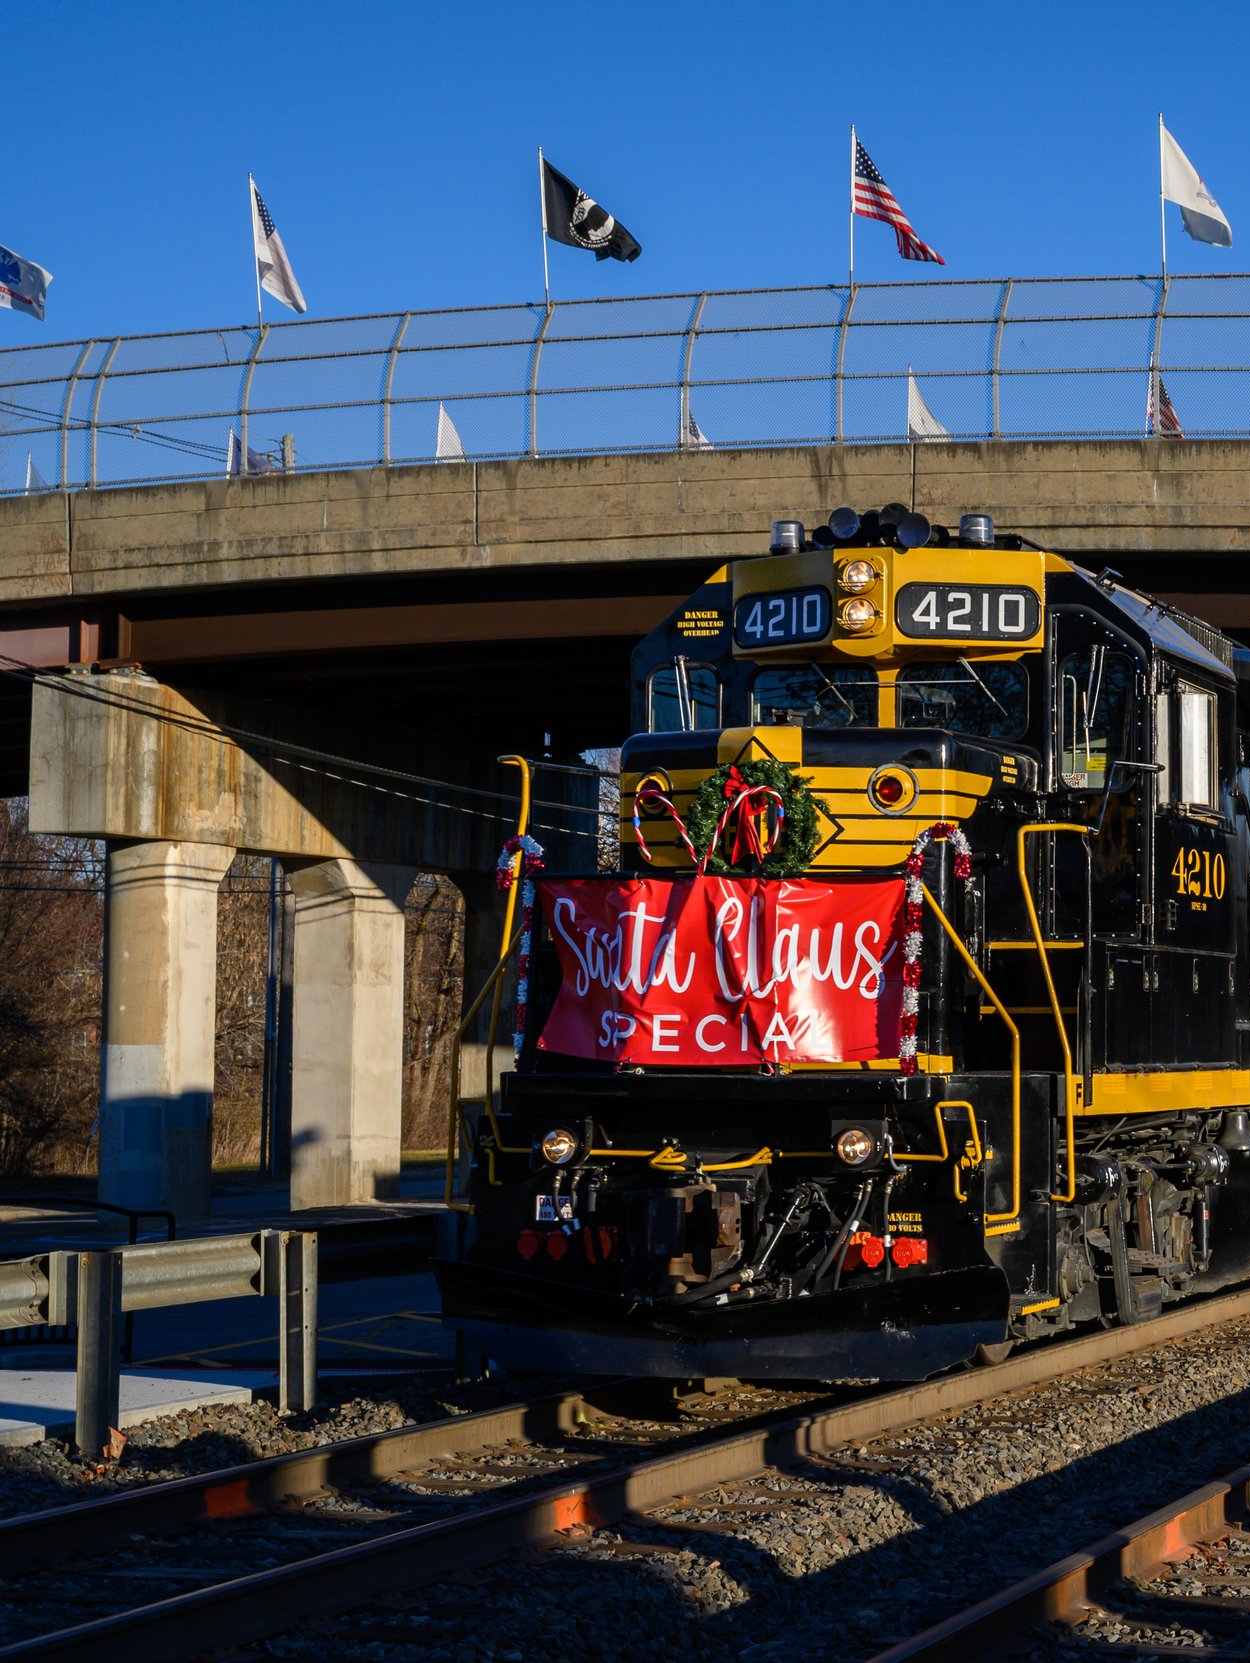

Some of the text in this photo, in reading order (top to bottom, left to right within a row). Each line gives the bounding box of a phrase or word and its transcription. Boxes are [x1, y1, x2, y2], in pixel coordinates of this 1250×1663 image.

[684, 611, 718, 619] DANGER
[744, 594, 821, 639] 4210
[911, 591, 1025, 633] 4210
[1171, 846, 1225, 900] 4210
[554, 896, 898, 1003] Santa Claus
[599, 1009, 833, 1053] SPECIAL
[1076, 1083, 1082, 1104] F
[538, 1197, 578, 1208] DAGE
[898, 1224, 923, 1232] VOLTS
